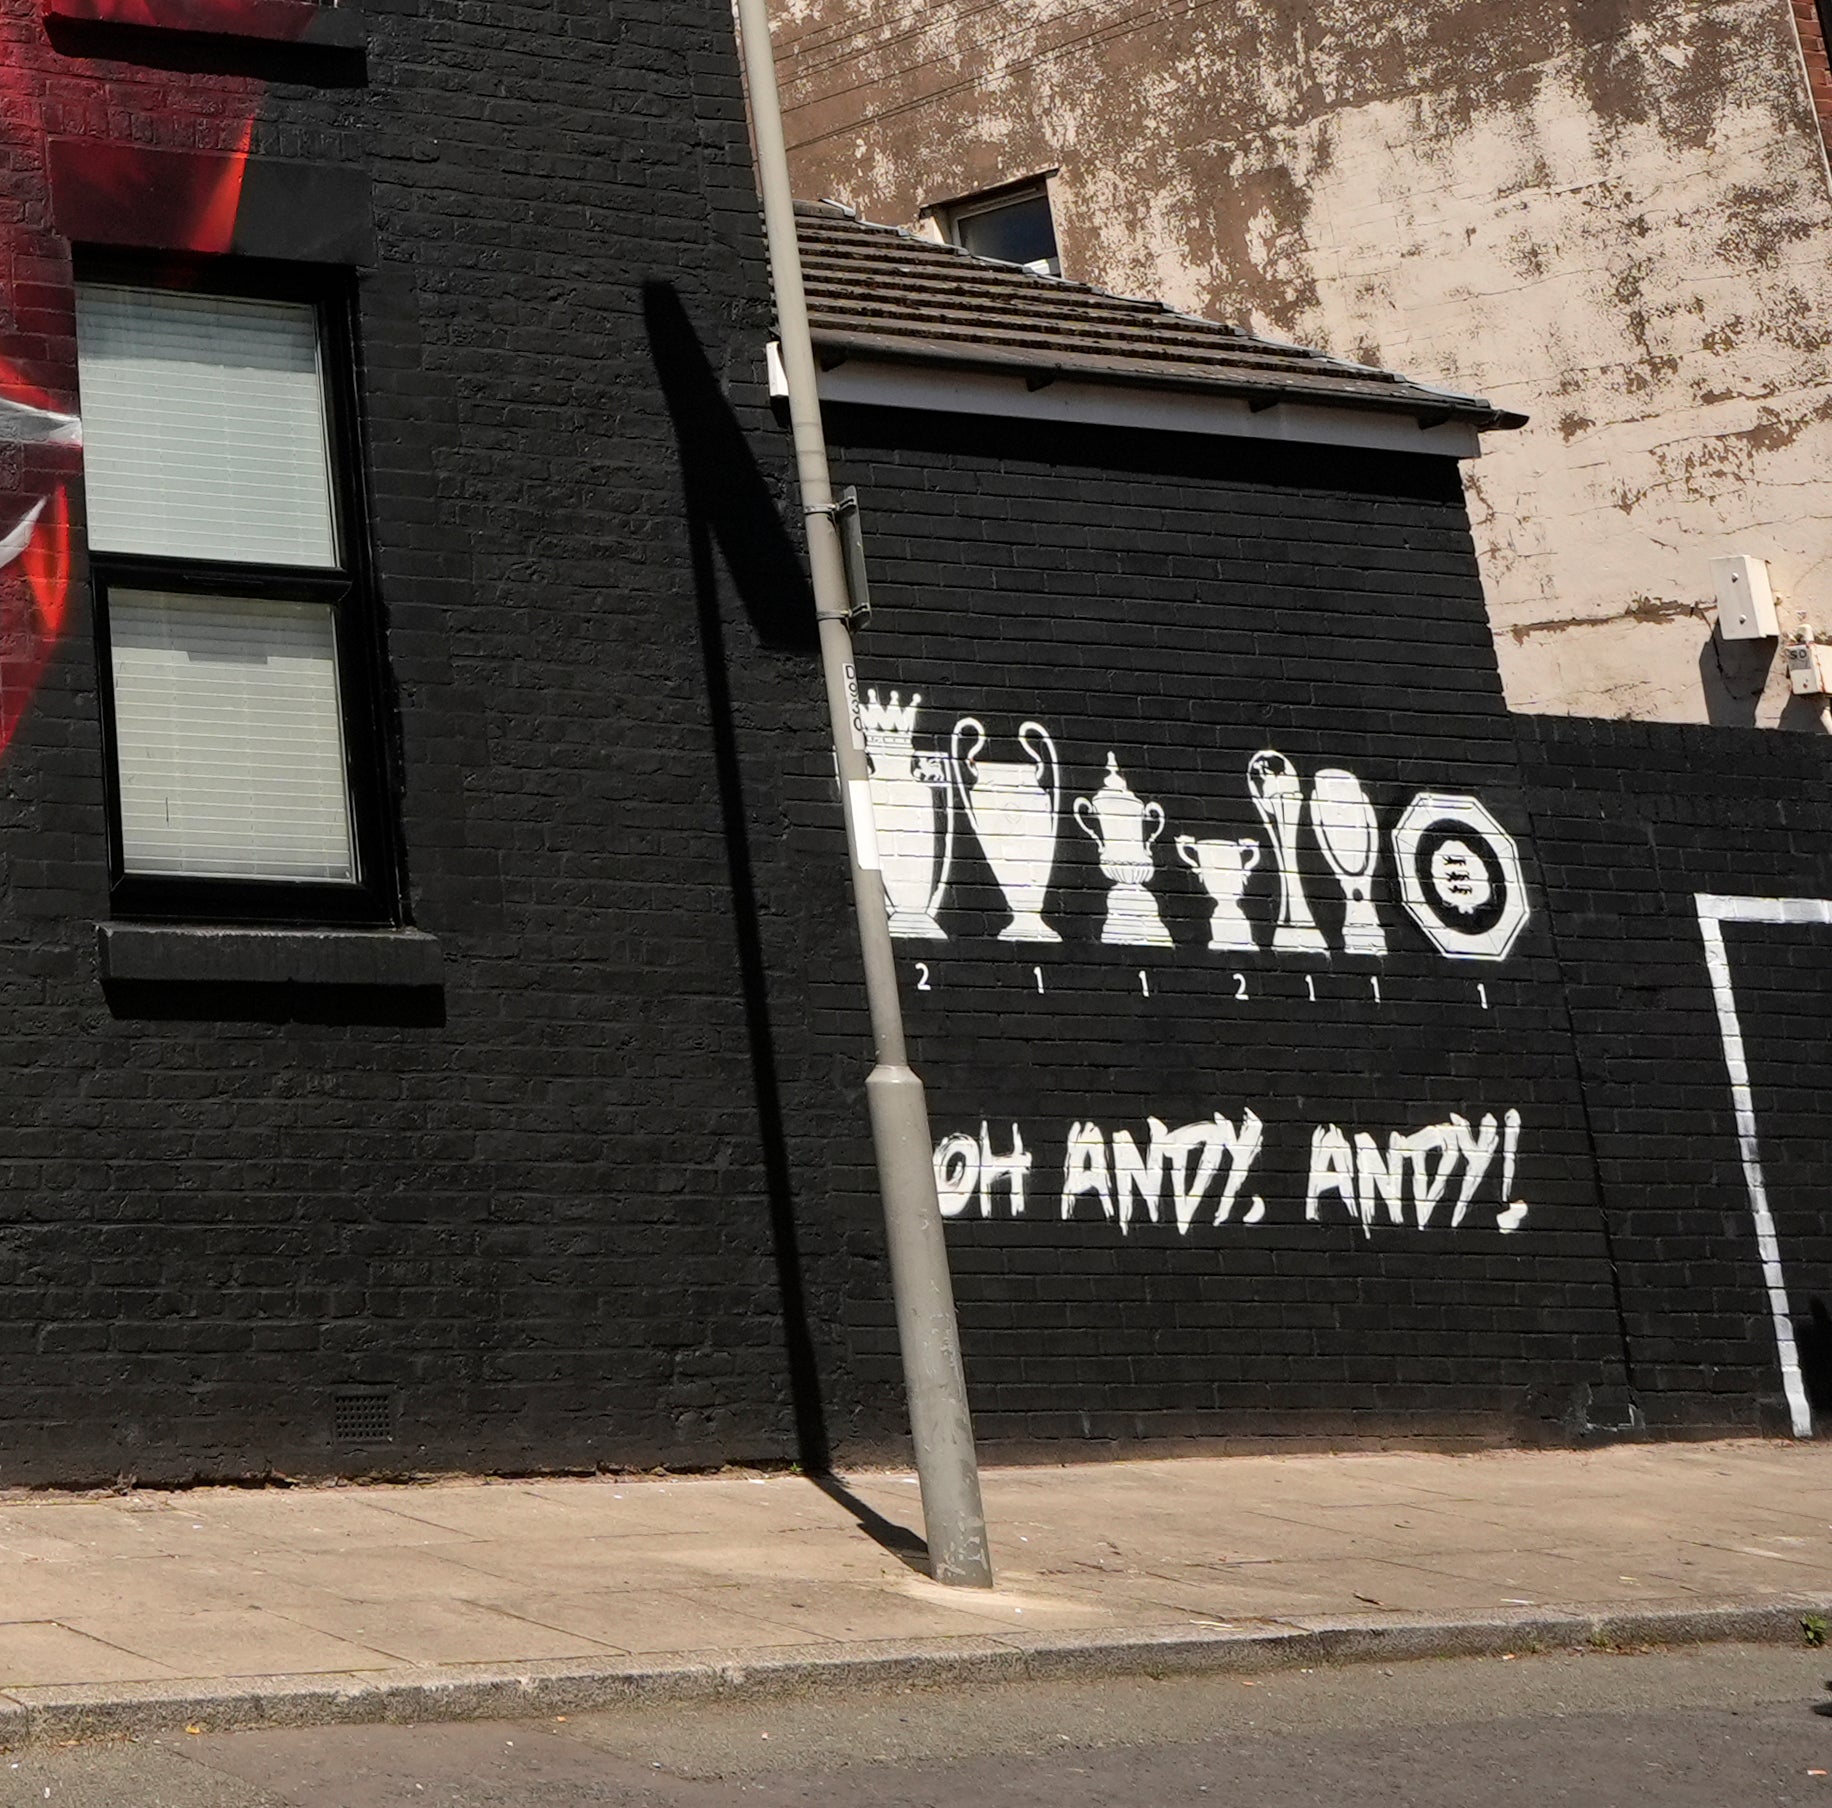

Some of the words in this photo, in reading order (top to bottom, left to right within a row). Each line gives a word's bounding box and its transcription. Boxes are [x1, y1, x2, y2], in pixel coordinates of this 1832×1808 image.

[916, 963, 932, 991] 2
[1033, 966, 1044, 994] 1
[1138, 969, 1149, 997] 1
[1233, 973, 1249, 1001] 2
[1306, 974, 1316, 1002] 1
[1370, 976, 1381, 1004] 1
[1477, 983, 1488, 1009] 1
[934, 1120, 1032, 1218] OH
[1305, 1108, 1528, 1238] ANDY!
